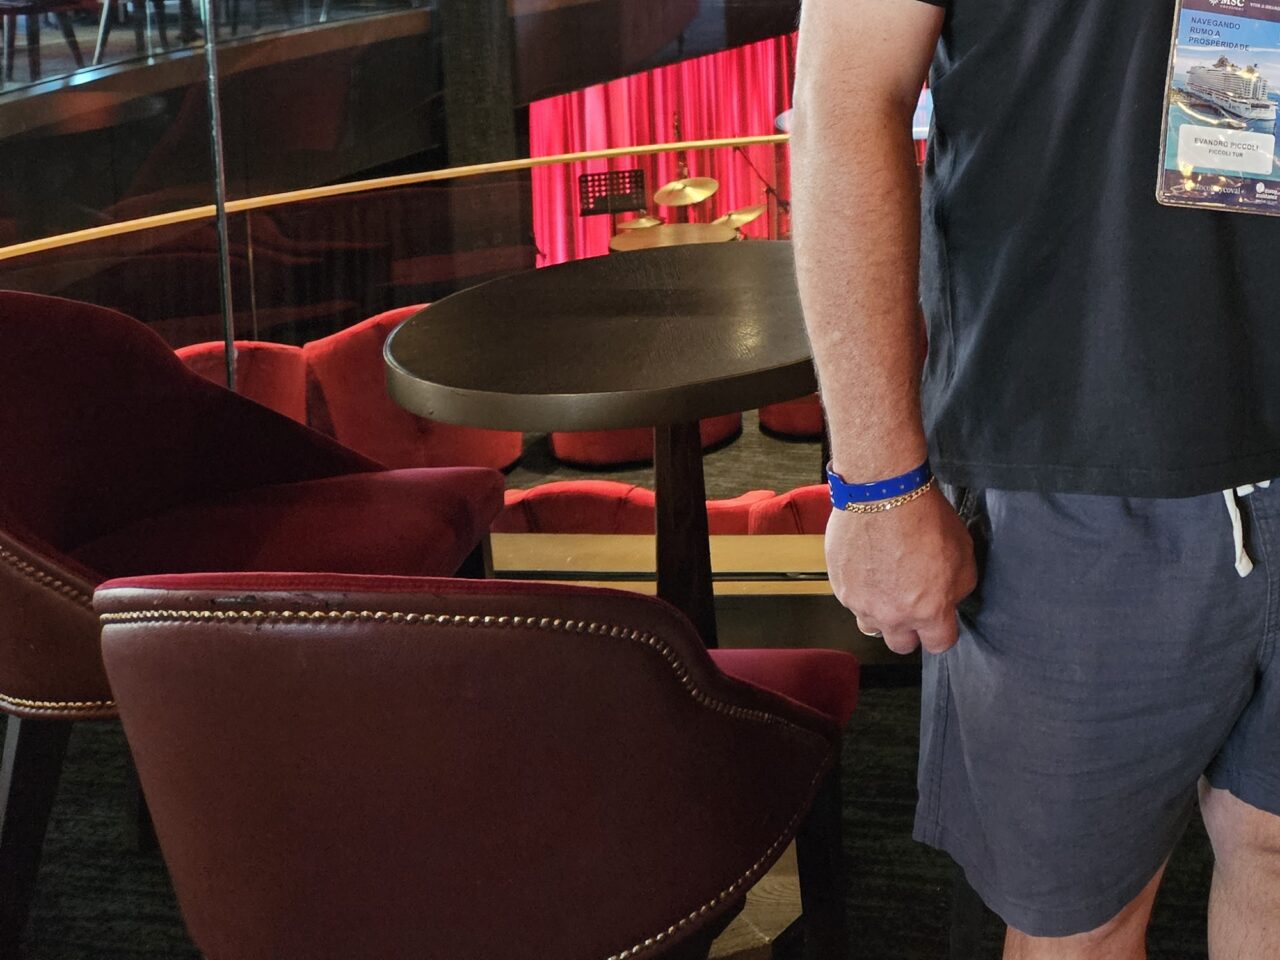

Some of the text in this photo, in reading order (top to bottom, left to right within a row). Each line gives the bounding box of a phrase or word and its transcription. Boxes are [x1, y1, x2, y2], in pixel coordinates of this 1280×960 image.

[1191, 17, 1241, 30] NAVEGANDO
[1190, 27, 1213, 37] RUMO
[1188, 36, 1250, 52] PROSPERIDADE
[1194, 137, 1259, 152] EVANDRO PICCOLI
